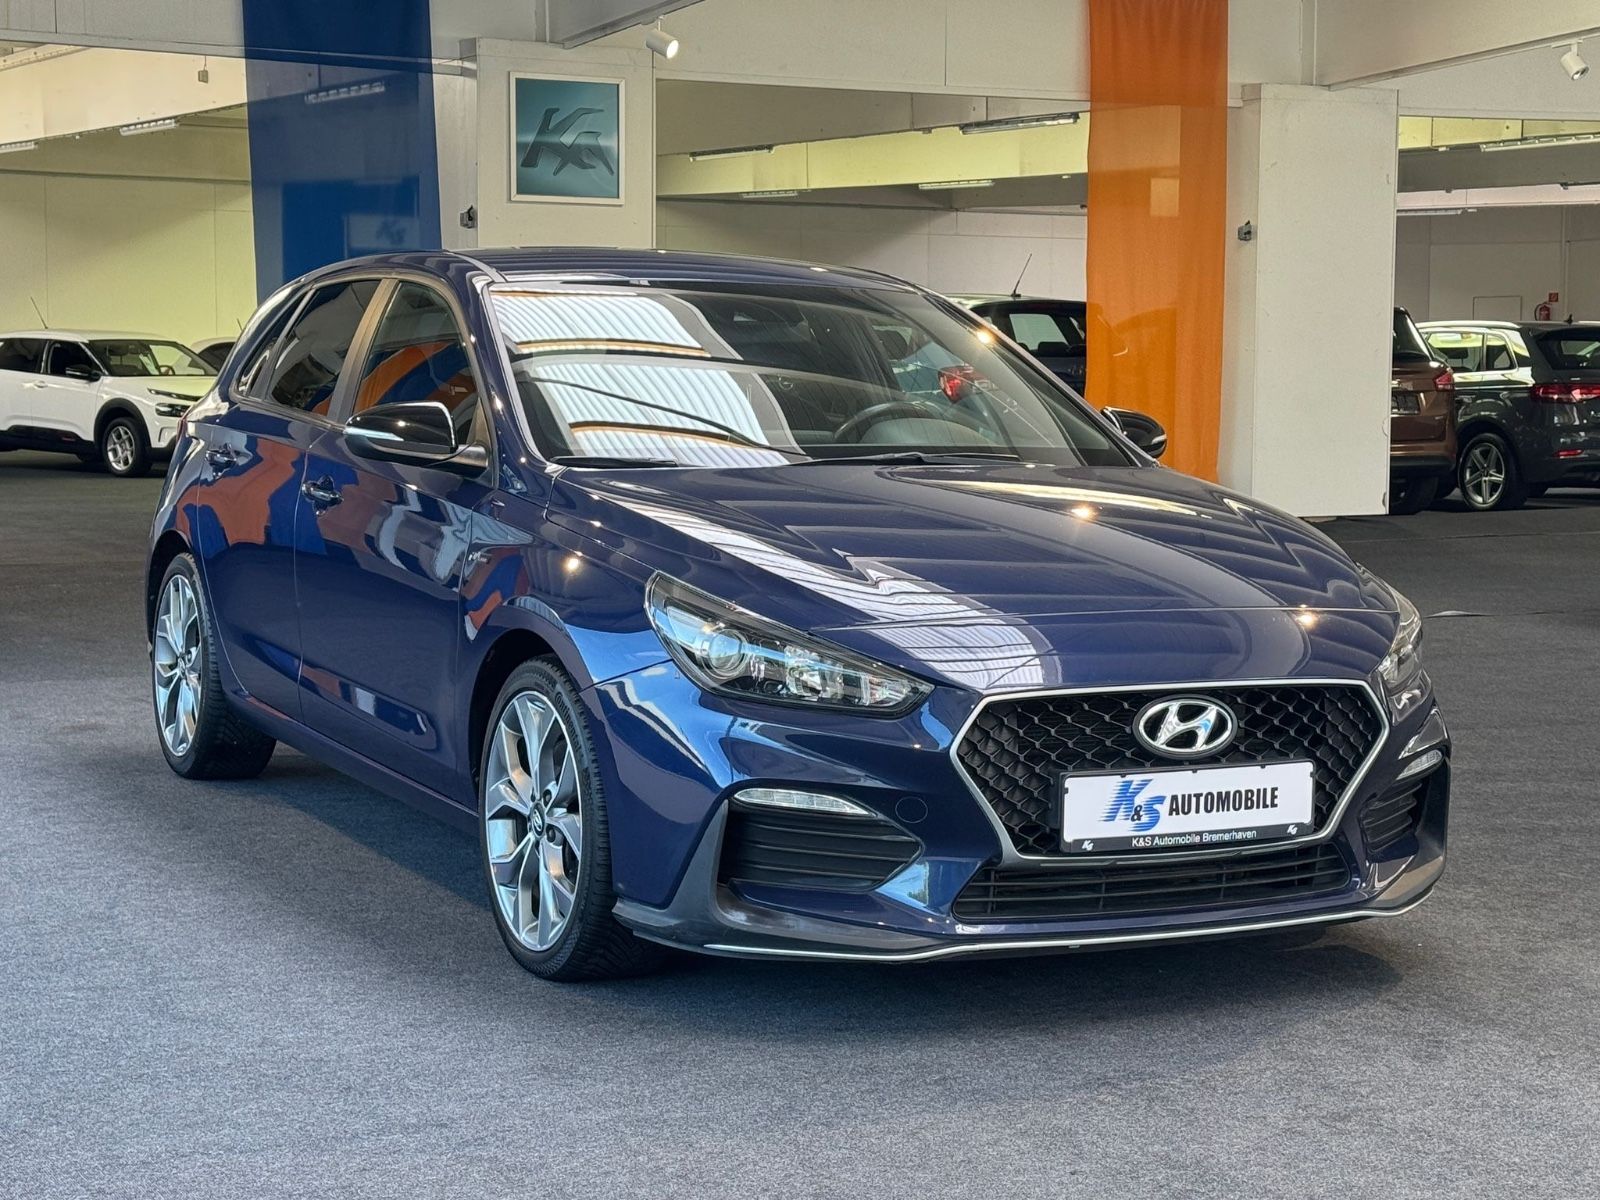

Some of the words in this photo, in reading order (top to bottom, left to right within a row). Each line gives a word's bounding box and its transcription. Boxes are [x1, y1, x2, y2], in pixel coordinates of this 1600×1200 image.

[1098, 779, 1167, 832] K&S
[1169, 787, 1279, 817] AUTOMOBILE
[1132, 836, 1152, 848] K&S
[1153, 832, 1200, 846] Automobile
[1202, 828, 1257, 842] Bremerhaven
